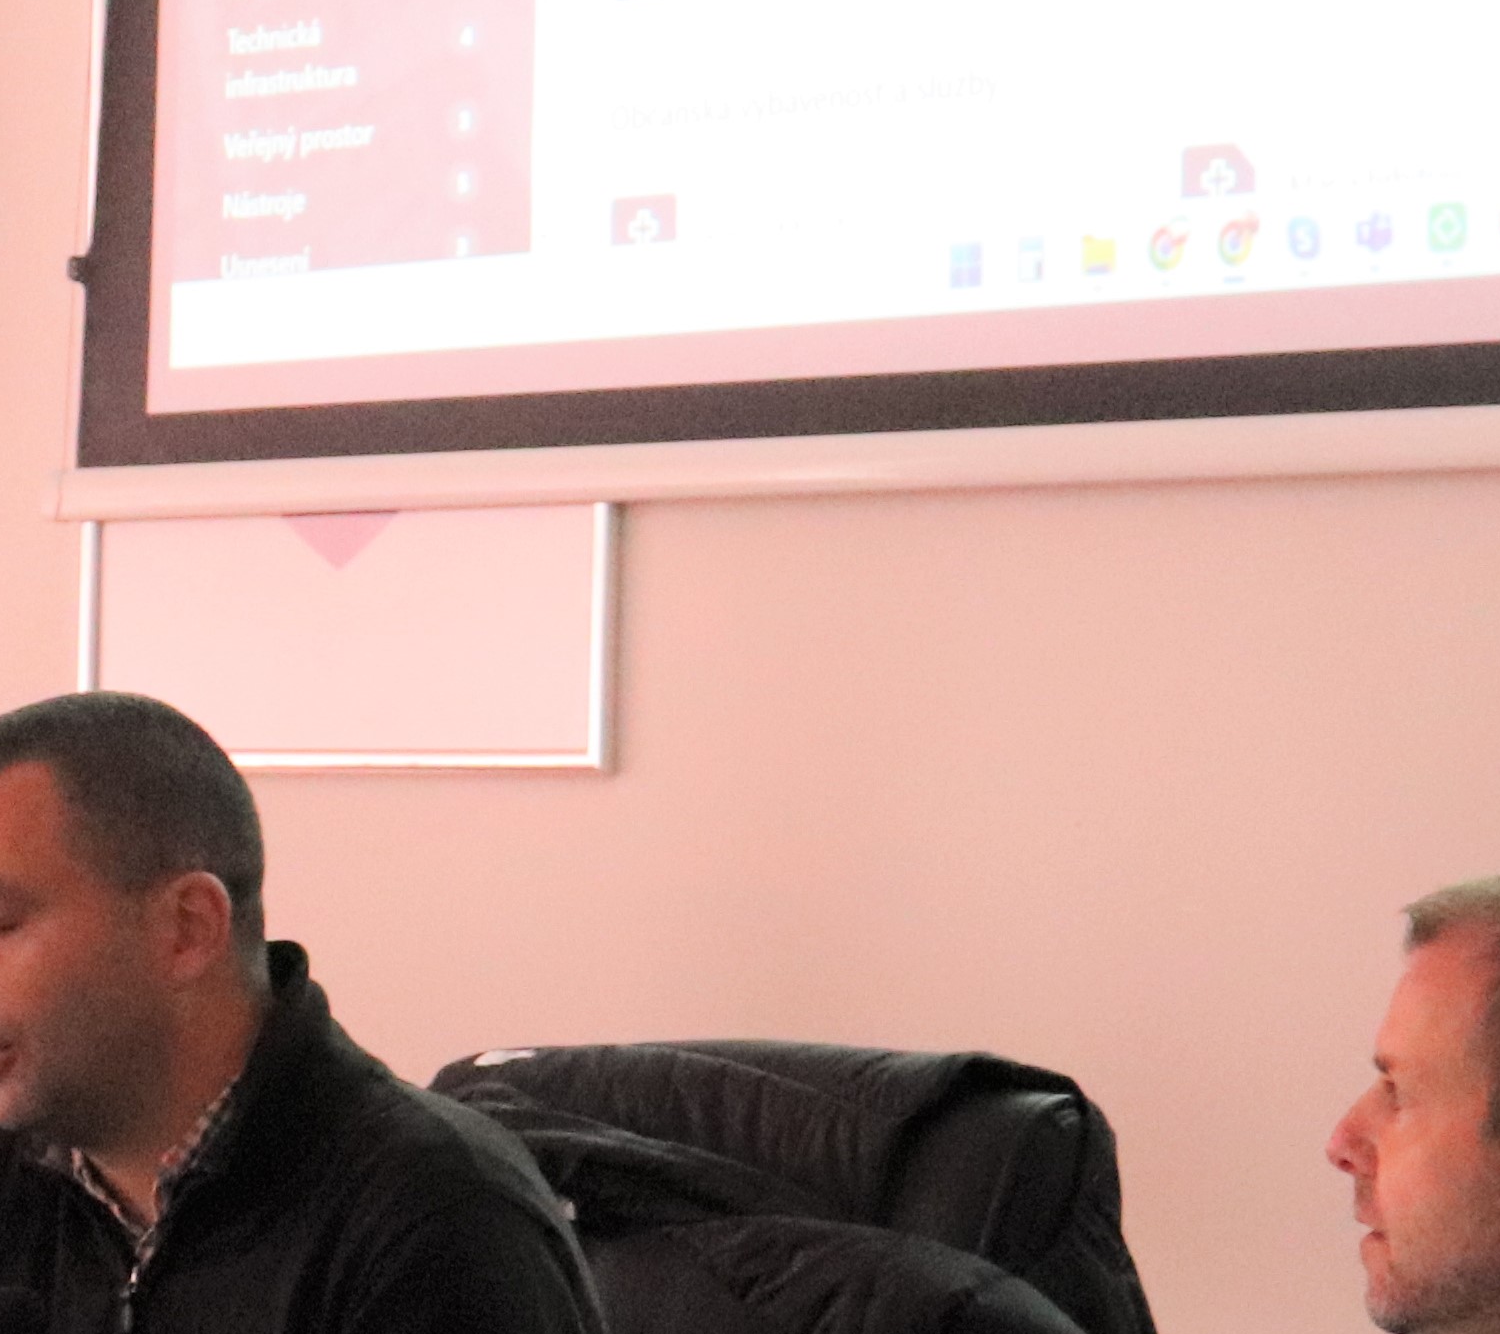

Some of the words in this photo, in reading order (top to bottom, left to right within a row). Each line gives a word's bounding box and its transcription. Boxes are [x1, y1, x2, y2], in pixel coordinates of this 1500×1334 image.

[226, 17, 322, 55] Technická
[225, 62, 359, 100] infrastruktura
[223, 124, 297, 164] Veřejný
[299, 123, 375, 160] prostor
[222, 188, 307, 223] Nástroje
